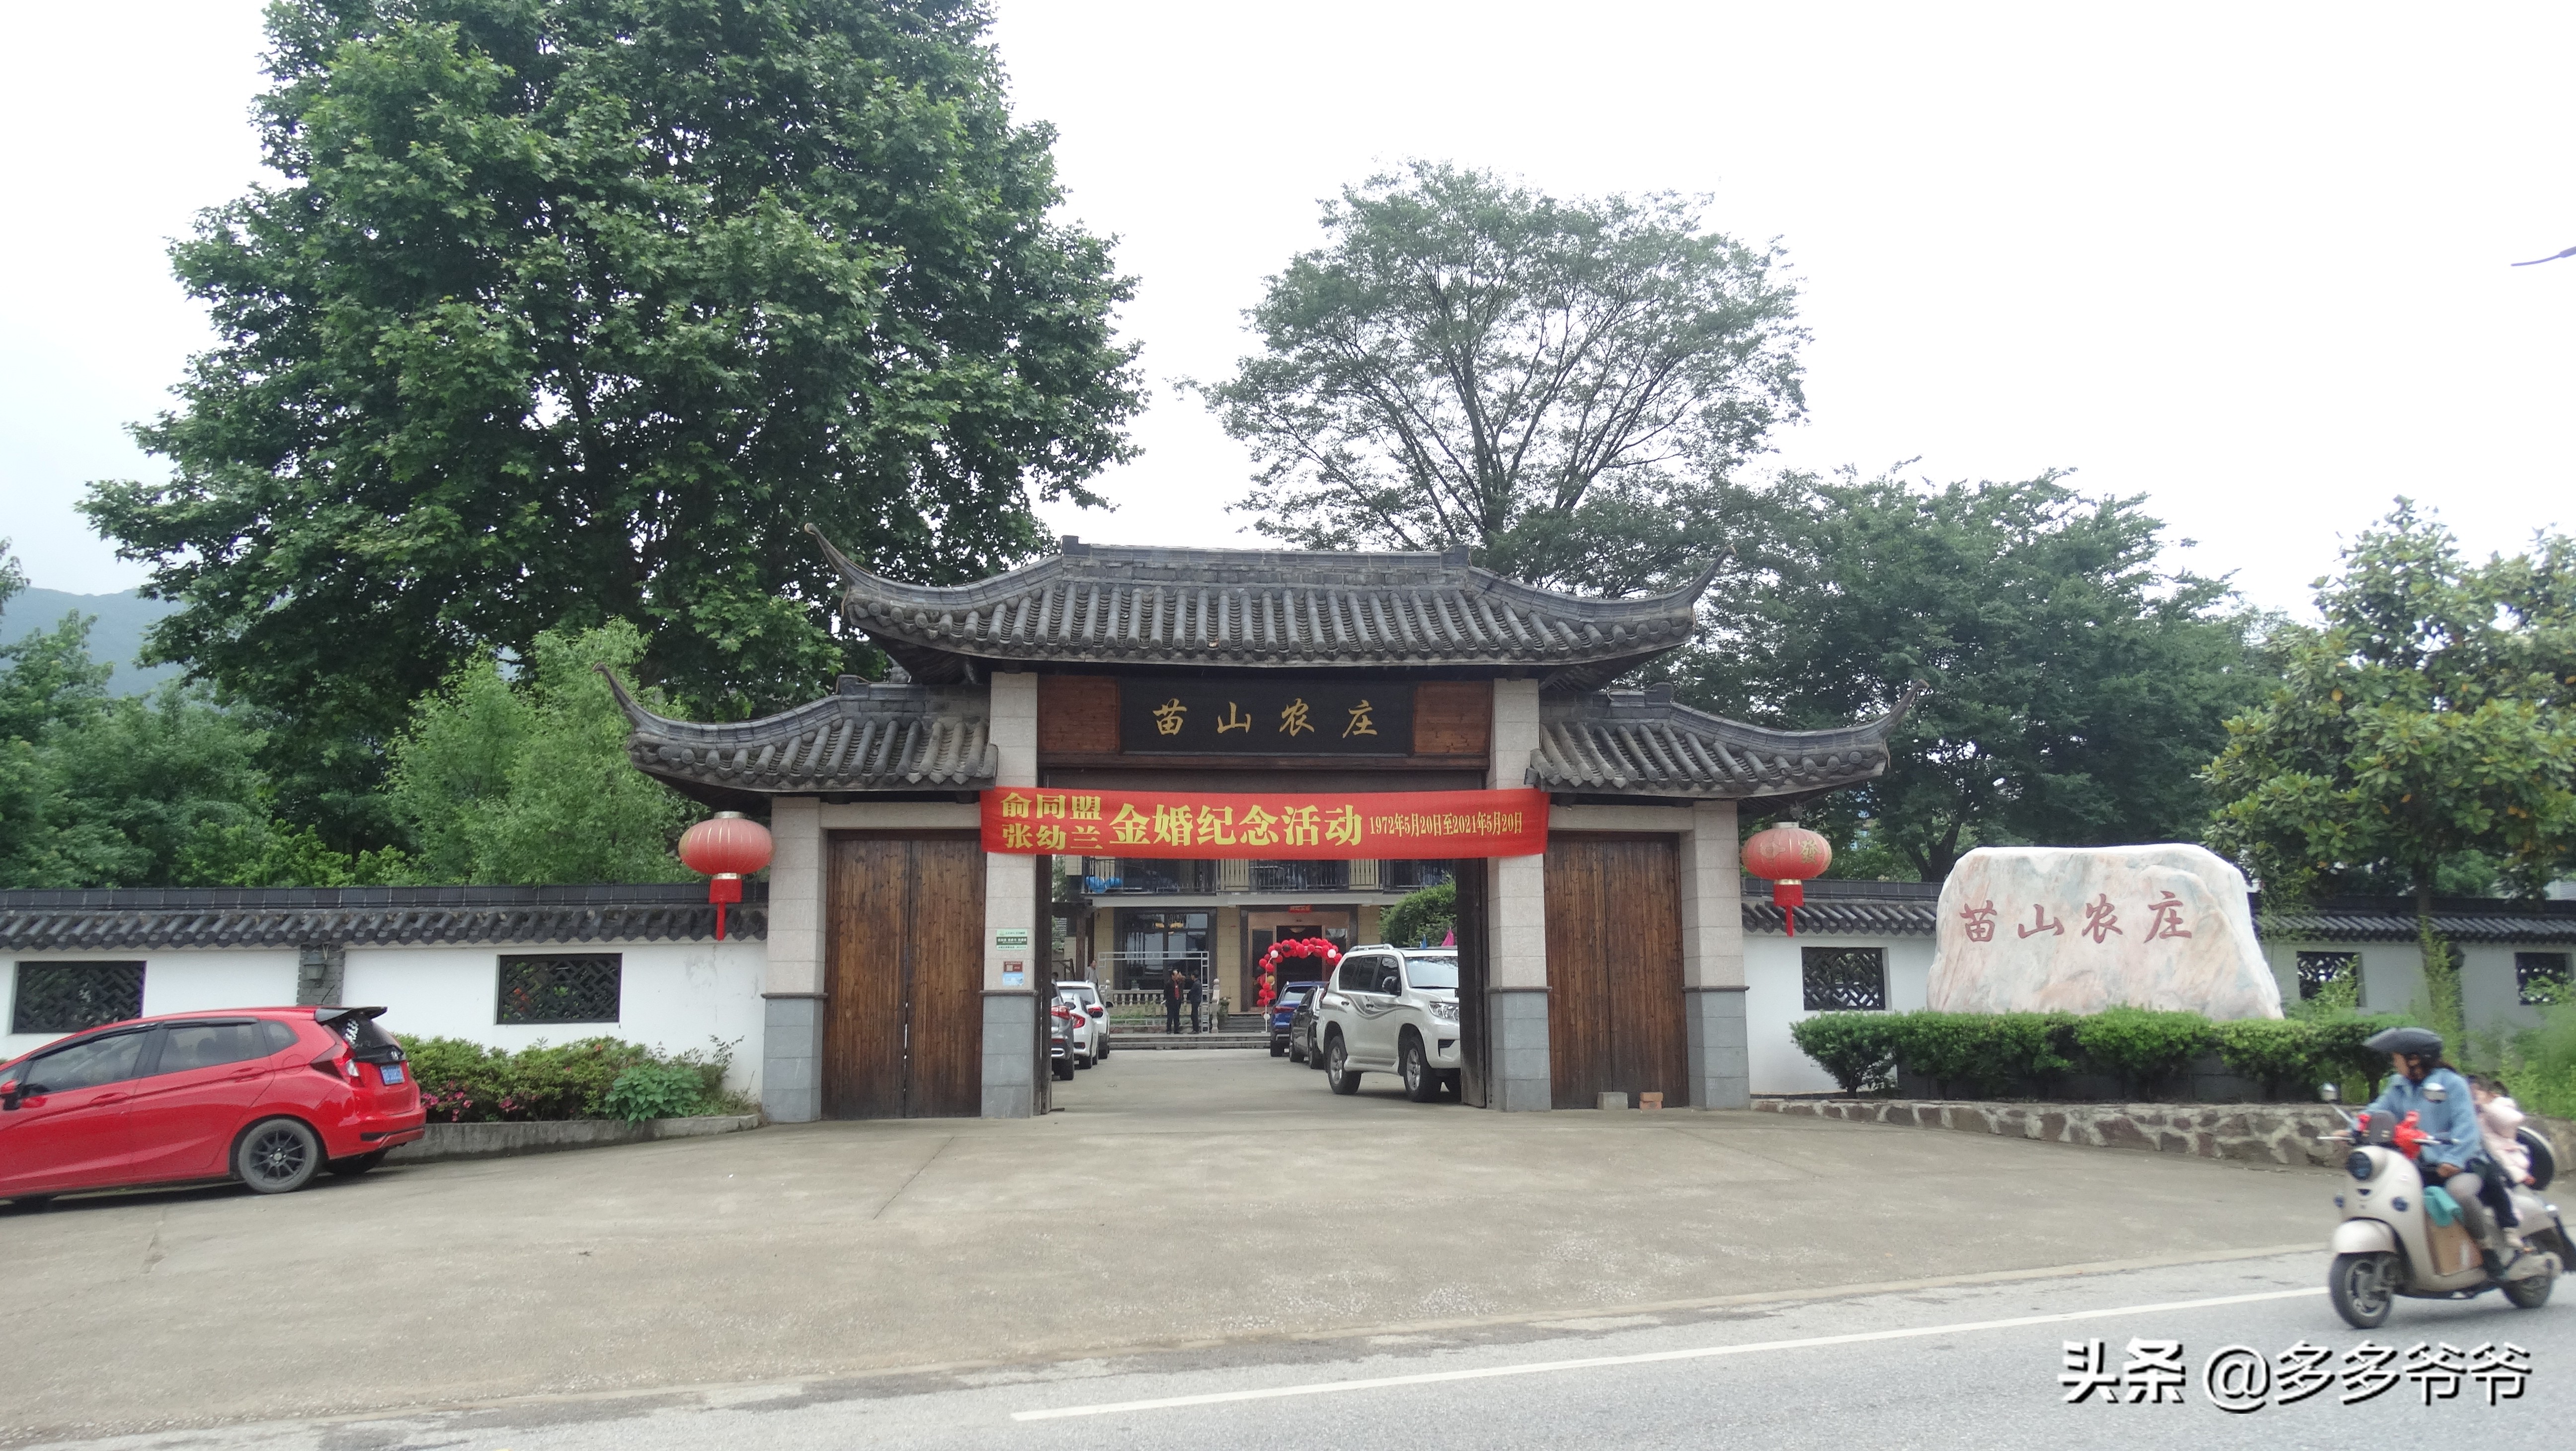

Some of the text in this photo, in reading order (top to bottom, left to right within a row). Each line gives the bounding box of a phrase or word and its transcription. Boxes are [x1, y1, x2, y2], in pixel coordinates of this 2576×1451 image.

[1152, 698, 1378, 738] 苗山农庄
[1000, 792, 1103, 820] 俞同盟
[1002, 823, 1103, 850] 张幼兰
[1109, 803, 1363, 846] 金婚纪念活动
[1369, 811, 1523, 837] 1972年5月20日至2021年5月20日
[1960, 890, 2192, 944] 苗山农庄
